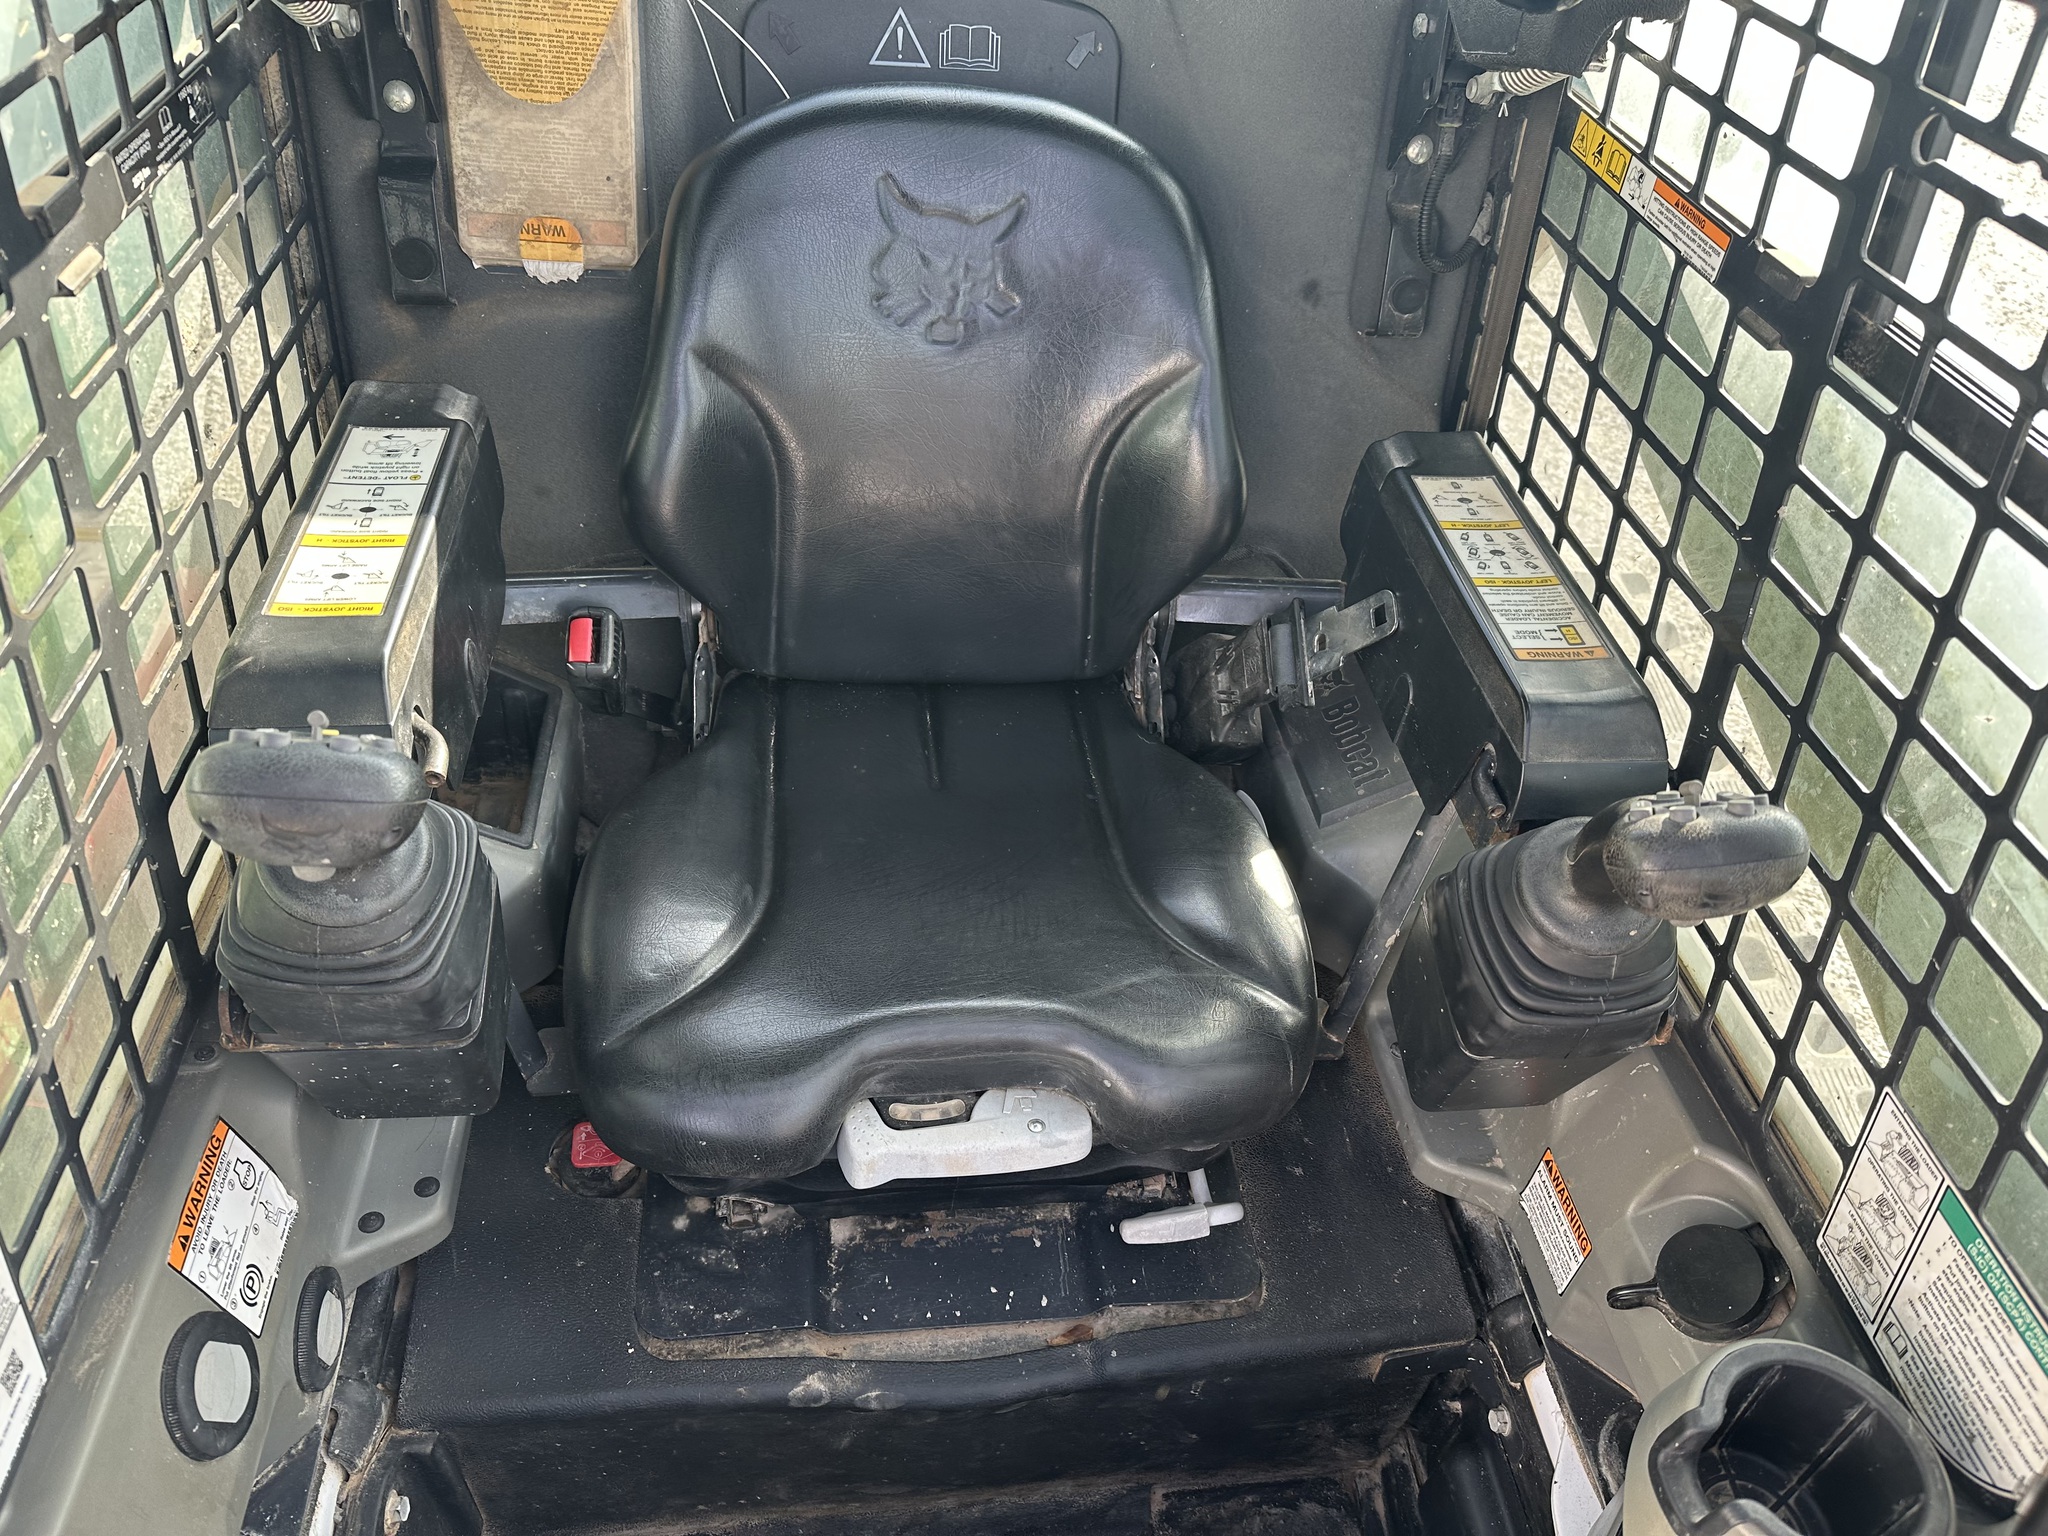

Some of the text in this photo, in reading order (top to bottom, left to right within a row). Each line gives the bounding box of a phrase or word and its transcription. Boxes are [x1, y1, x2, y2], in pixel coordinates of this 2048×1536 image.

[1653, 196, 1665, 208] HITTING
[1664, 205, 1686, 227] OBSTRUCTIONS
[1689, 227, 1698, 237] HIGH
[1697, 234, 1709, 247] RANGE
[1707, 243, 1721, 257] SPEEDS
[1663, 213, 1674, 224] CAUSE
[1672, 221, 1686, 236] SERIOUS
[1685, 232, 1697, 244] INJURY
[1700, 246, 1712, 258] DEATH
[1679, 200, 1706, 229] WARNING
[1526, 650, 1584, 658] WARNING
[1318, 693, 1391, 791] Bobcat
[1890, 1109, 1938, 1181] ENTERING THE LOADER
[182, 1133, 221, 1228] WARNING
[191, 1150, 227, 1253] AVOID INJURY OR DEATH
[241, 1161, 253, 1189] STOP
[1867, 1156, 1915, 1233] OPERATING THE LOADER
[197, 1160, 231, 1254] TO LEAVE THE LOADER:
[1537, 1169, 1552, 1200] ALARM
[1550, 1200, 1564, 1227] MUST
[1562, 1228, 1579, 1265] SOUND!
[1551, 1169, 1588, 1253] WARNING
[1847, 1209, 1889, 1278] LEAVING THE LOADER
[1974, 1237, 2020, 1302] OPERATION
[219, 1280, 227, 1297] Lower
[227, 1261, 238, 1290] attachment
[245, 1275, 256, 1294] P
[1941, 1269, 1954, 1286] start
[1947, 1234, 2012, 1334] TO OPERATE LOADER:
[1966, 1242, 1988, 1273] (SJC)
[1986, 1272, 2001, 1291] OR
[1997, 1290, 2027, 1331] (SCPA)
[1917, 1294, 1948, 1345] button on left
[1921, 1291, 1956, 1346] Activate Green
[1931, 1280, 1978, 1355] Select control mode
[1940, 1282, 1963, 1317] equipped
[1962, 1318, 1973, 1335] with
[1946, 1264, 2004, 1357] Put joysticks or steering
[1951, 1257, 1969, 1284] Fasten
[1968, 1285, 1981, 1301] seat
[1979, 1301, 1991, 1317] belt
[1989, 1318, 2001, 1334] and
[2000, 1334, 2016, 1356] lower
[1899, 1365, 1913, 1390] more
[1904, 1359, 1923, 1389] Manual
[1920, 1389, 1932, 1405] and
[1909, 1354, 1943, 1411] See Operation
[1912, 1335, 1932, 1366] lowered
[1936, 1375, 1946, 1390] key
[1917, 1329, 1934, 1356] button
[1932, 1356, 1947, 1378] again
